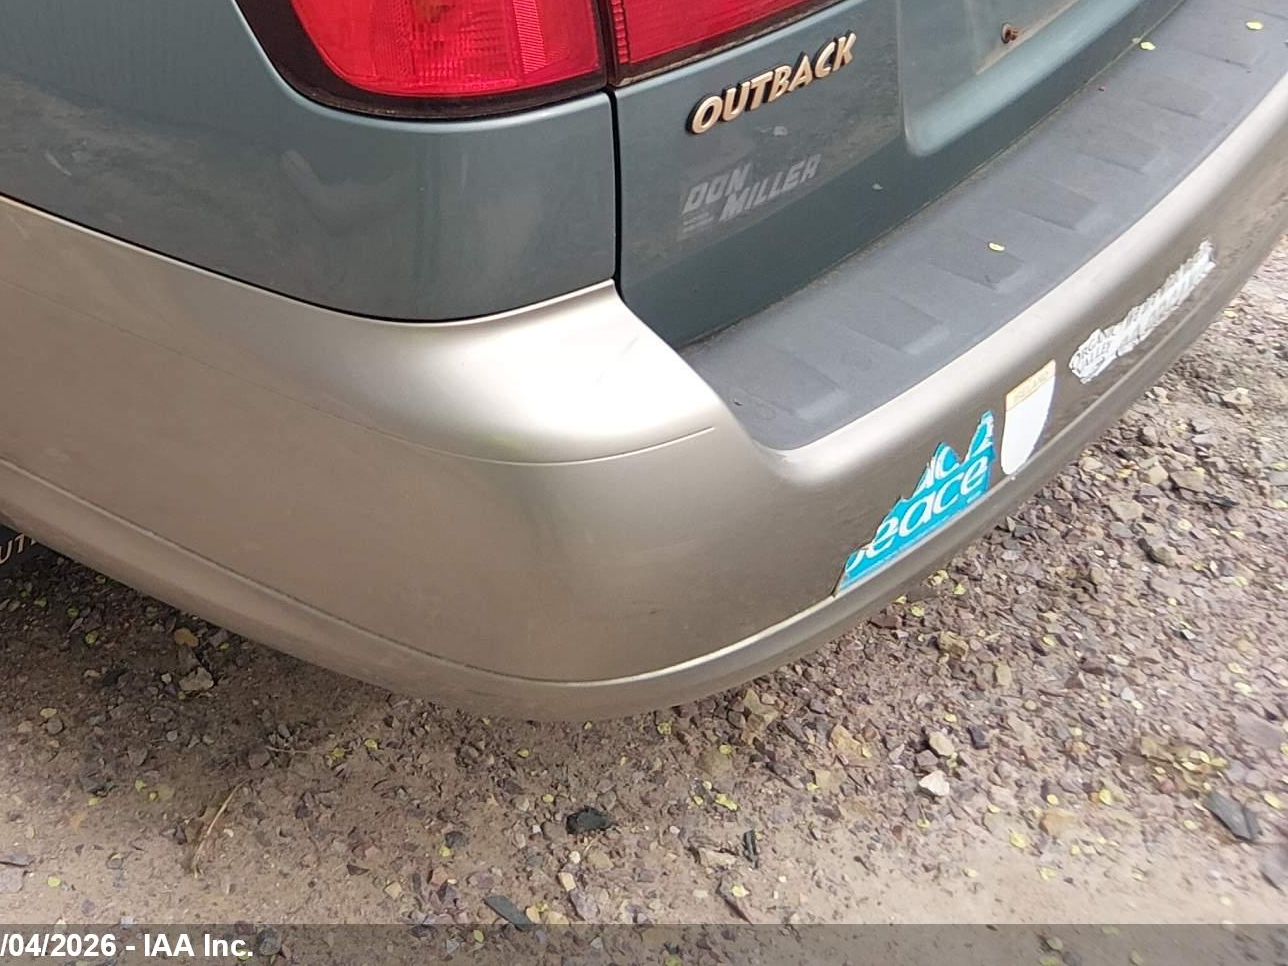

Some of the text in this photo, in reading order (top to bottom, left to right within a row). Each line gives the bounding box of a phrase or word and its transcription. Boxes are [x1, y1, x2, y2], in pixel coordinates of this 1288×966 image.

[685, 29, 857, 135] OUTBACK
[681, 161, 752, 215] DON
[718, 153, 822, 223] MILLER
[845, 455, 989, 574] eace
